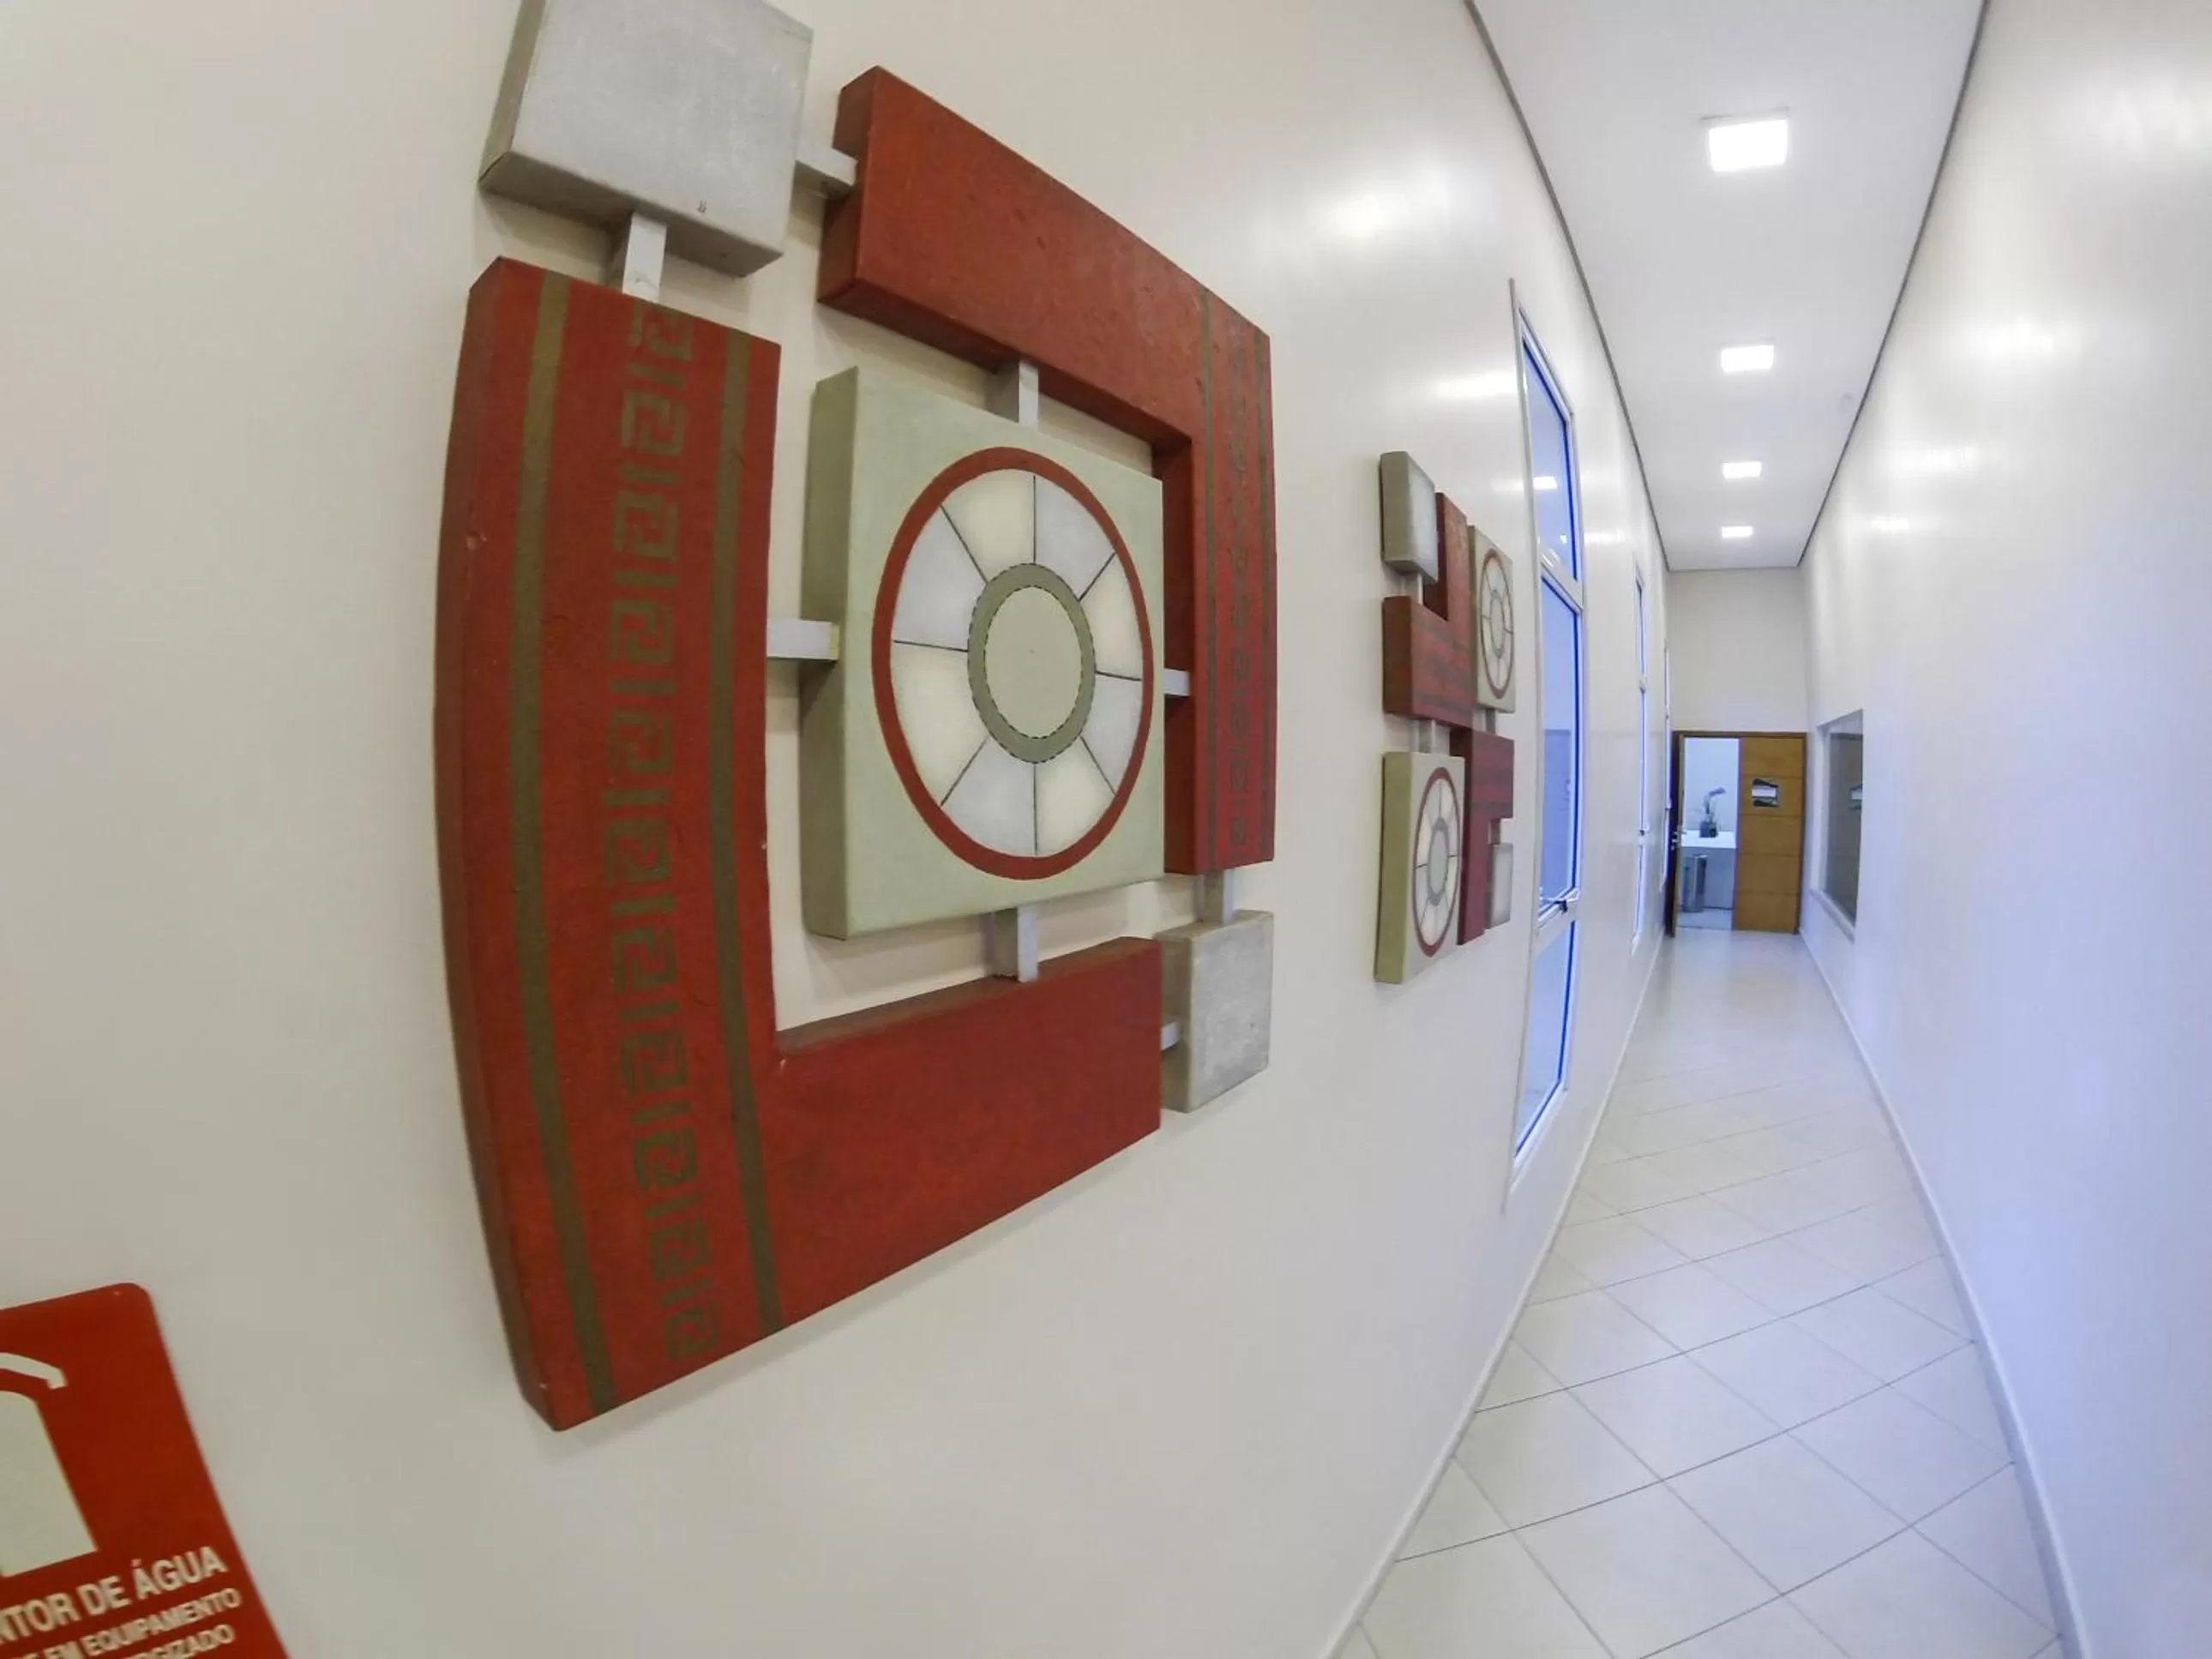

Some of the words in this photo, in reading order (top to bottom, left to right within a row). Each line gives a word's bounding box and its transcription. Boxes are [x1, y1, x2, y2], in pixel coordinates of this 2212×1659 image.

[76, 1575, 132, 1615] DE
[131, 1545, 229, 1600] ÁGUA
[80, 1587, 242, 1656] EQUIPAMENTO
